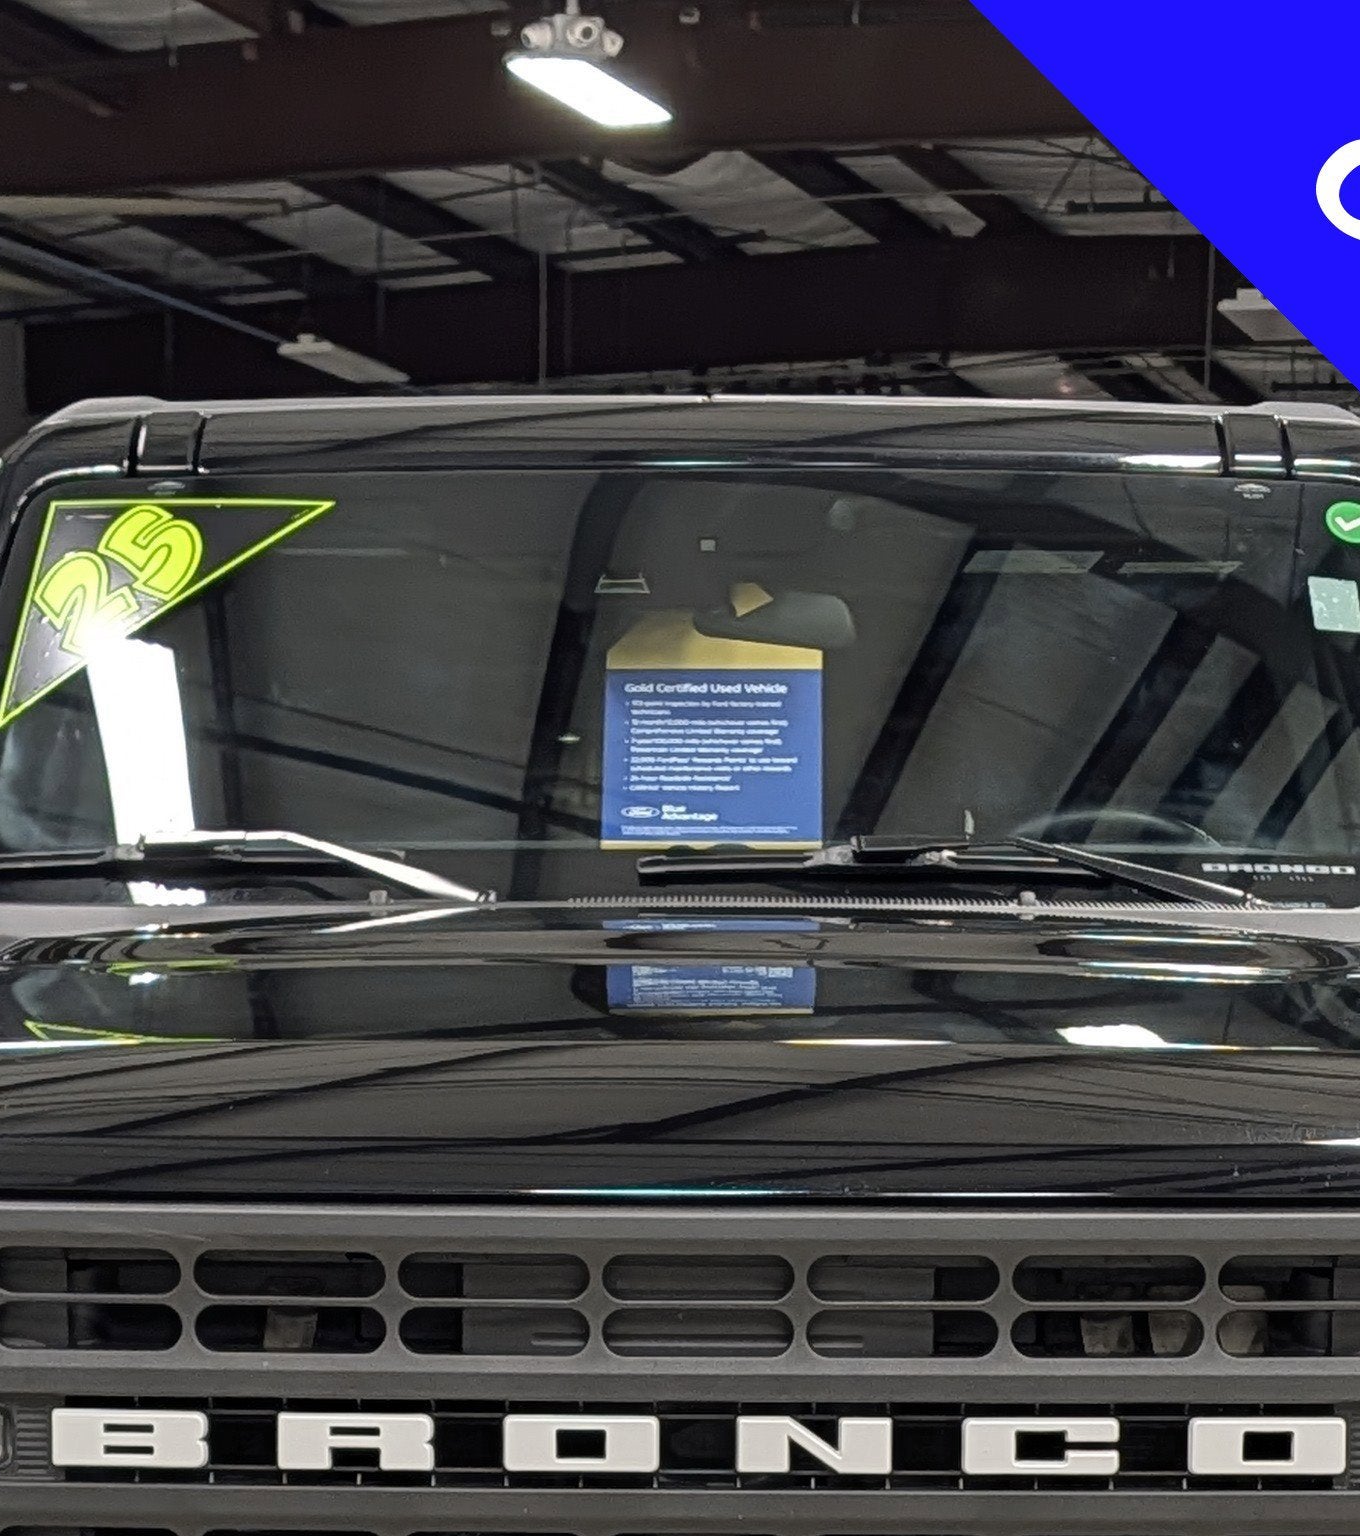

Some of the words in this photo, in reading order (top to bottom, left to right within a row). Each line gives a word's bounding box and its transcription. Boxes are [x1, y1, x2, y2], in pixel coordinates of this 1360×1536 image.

[33, 503, 203, 654] 25
[624, 683, 654, 694] Gold
[656, 683, 707, 694] Certified
[709, 683, 742, 694] Used
[744, 683, 789, 694] Vehicle
[661, 804, 687, 813] Blue
[1201, 863, 1357, 875] BRONCO
[52, 1406, 1348, 1475] BRONCO
